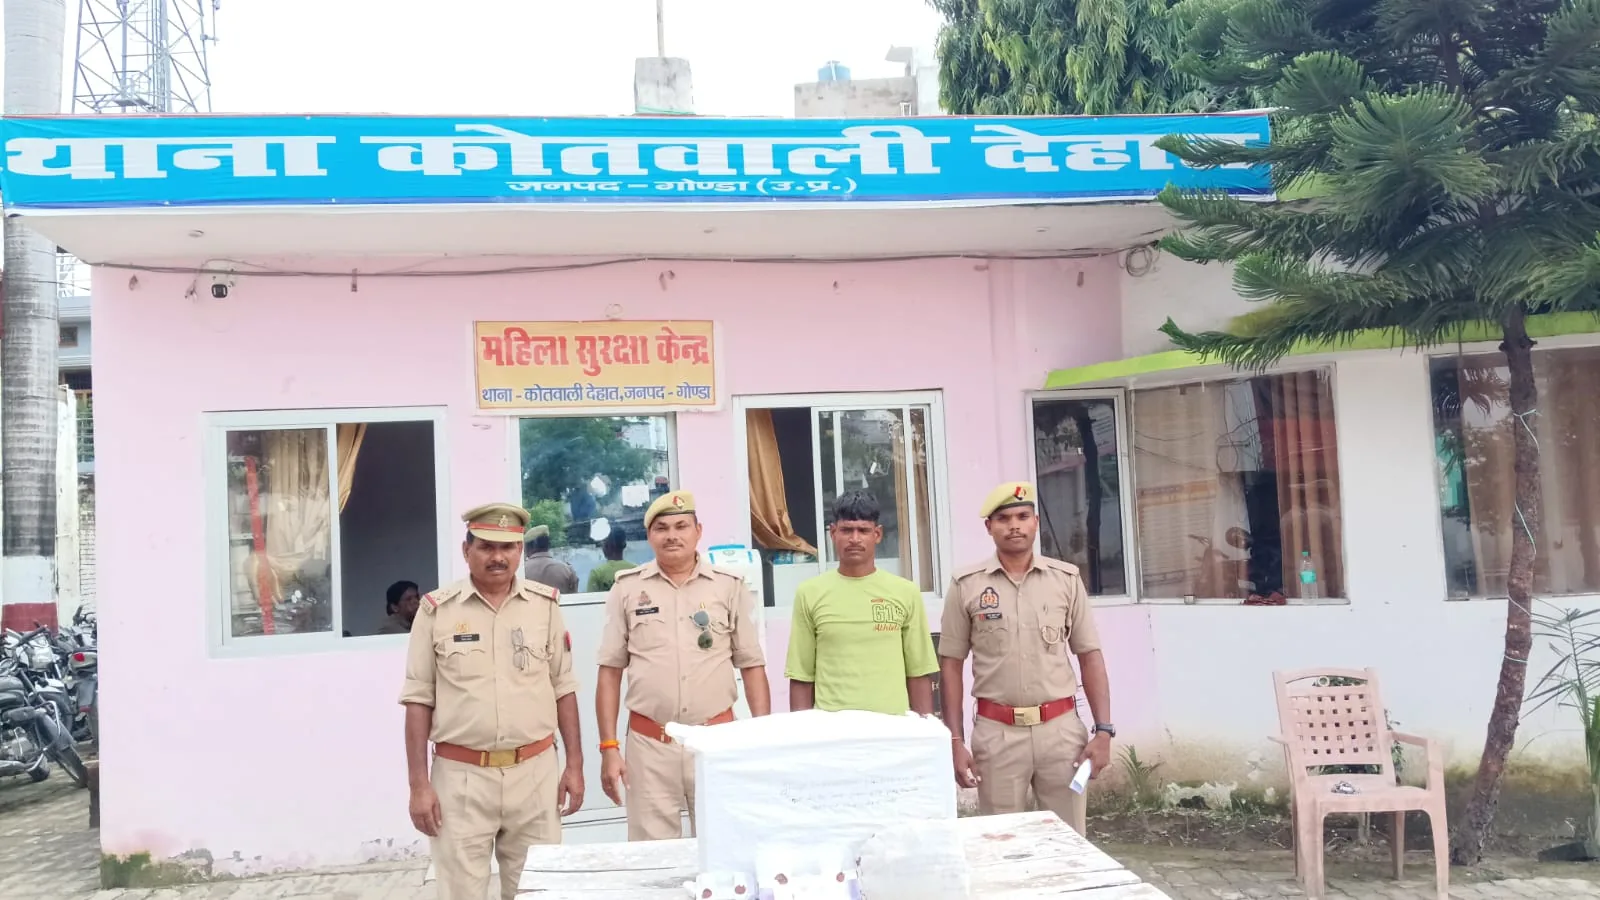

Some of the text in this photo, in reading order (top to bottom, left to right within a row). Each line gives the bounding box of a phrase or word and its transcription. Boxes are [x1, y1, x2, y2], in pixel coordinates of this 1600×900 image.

[5, 136, 337, 180] थाना
[359, 123, 951, 176] कोतवाली
[505, 181, 624, 191] जनपद
[653, 178, 749, 191] गोण्डा
[481, 326, 711, 377] महिला सुरक्षा केन्द्र
[482, 387, 513, 402] थाना
[524, 383, 584, 402] कोतवाली
[676, 382, 711, 400] गोण्डा
